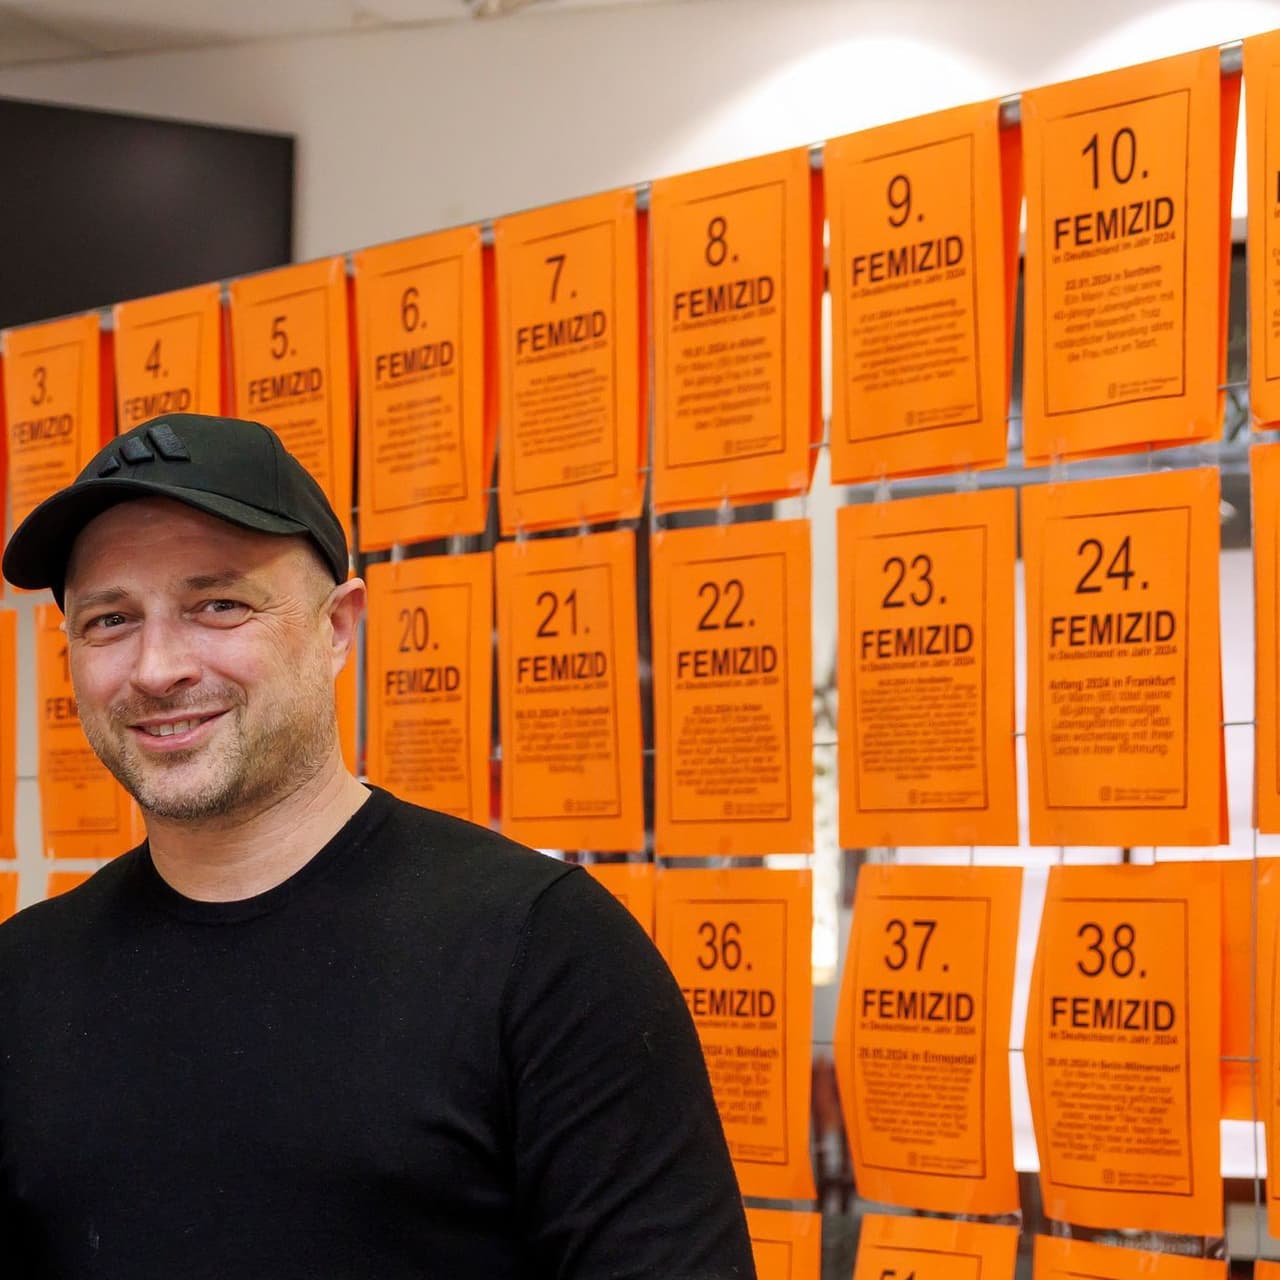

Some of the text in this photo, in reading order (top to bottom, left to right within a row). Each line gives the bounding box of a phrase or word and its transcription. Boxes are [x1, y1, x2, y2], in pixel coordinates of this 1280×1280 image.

[1081, 126, 1149, 190] 10.
[887, 173, 924, 229] 9.
[705, 216, 739, 268] 8.
[1054, 196, 1175, 251] FEMIZID
[1153, 231, 1175, 245] 2024
[545, 253, 577, 303] 7.
[852, 235, 964, 286] FEMIZID
[401, 286, 427, 333] 6.
[674, 275, 774, 320] FEMIZID
[271, 315, 296, 360] 5.
[517, 310, 606, 353] FEMIZID
[145, 339, 169, 378] 4.
[376, 341, 454, 380] FEMIZID
[31, 366, 53, 407] 3.
[249, 367, 322, 403] FEMIZID
[13, 413, 74, 445] FEMIZID
[881, 553, 947, 610] 23.
[1074, 535, 1149, 595] 24.
[535, 589, 590, 639] 21.
[697, 578, 755, 632] 22.
[399, 606, 439, 653] 20.
[861, 623, 974, 659] FEMIZID
[1050, 609, 1177, 648] FEMIZID
[517, 651, 607, 683] FEMIZID
[677, 644, 778, 678] FEMIZID
[1155, 646, 1177, 656] 2024
[386, 666, 460, 695] FEMIZID
[1086, 678, 1109, 689] 2024
[696, 920, 753, 972] 36.
[883, 918, 950, 973] 37.
[1076, 922, 1147, 979] 38.
[862, 988, 975, 1023] FEMIZID
[1051, 996, 1176, 1032] FEMIZID
[1153, 1035, 1178, 1044] 2024
